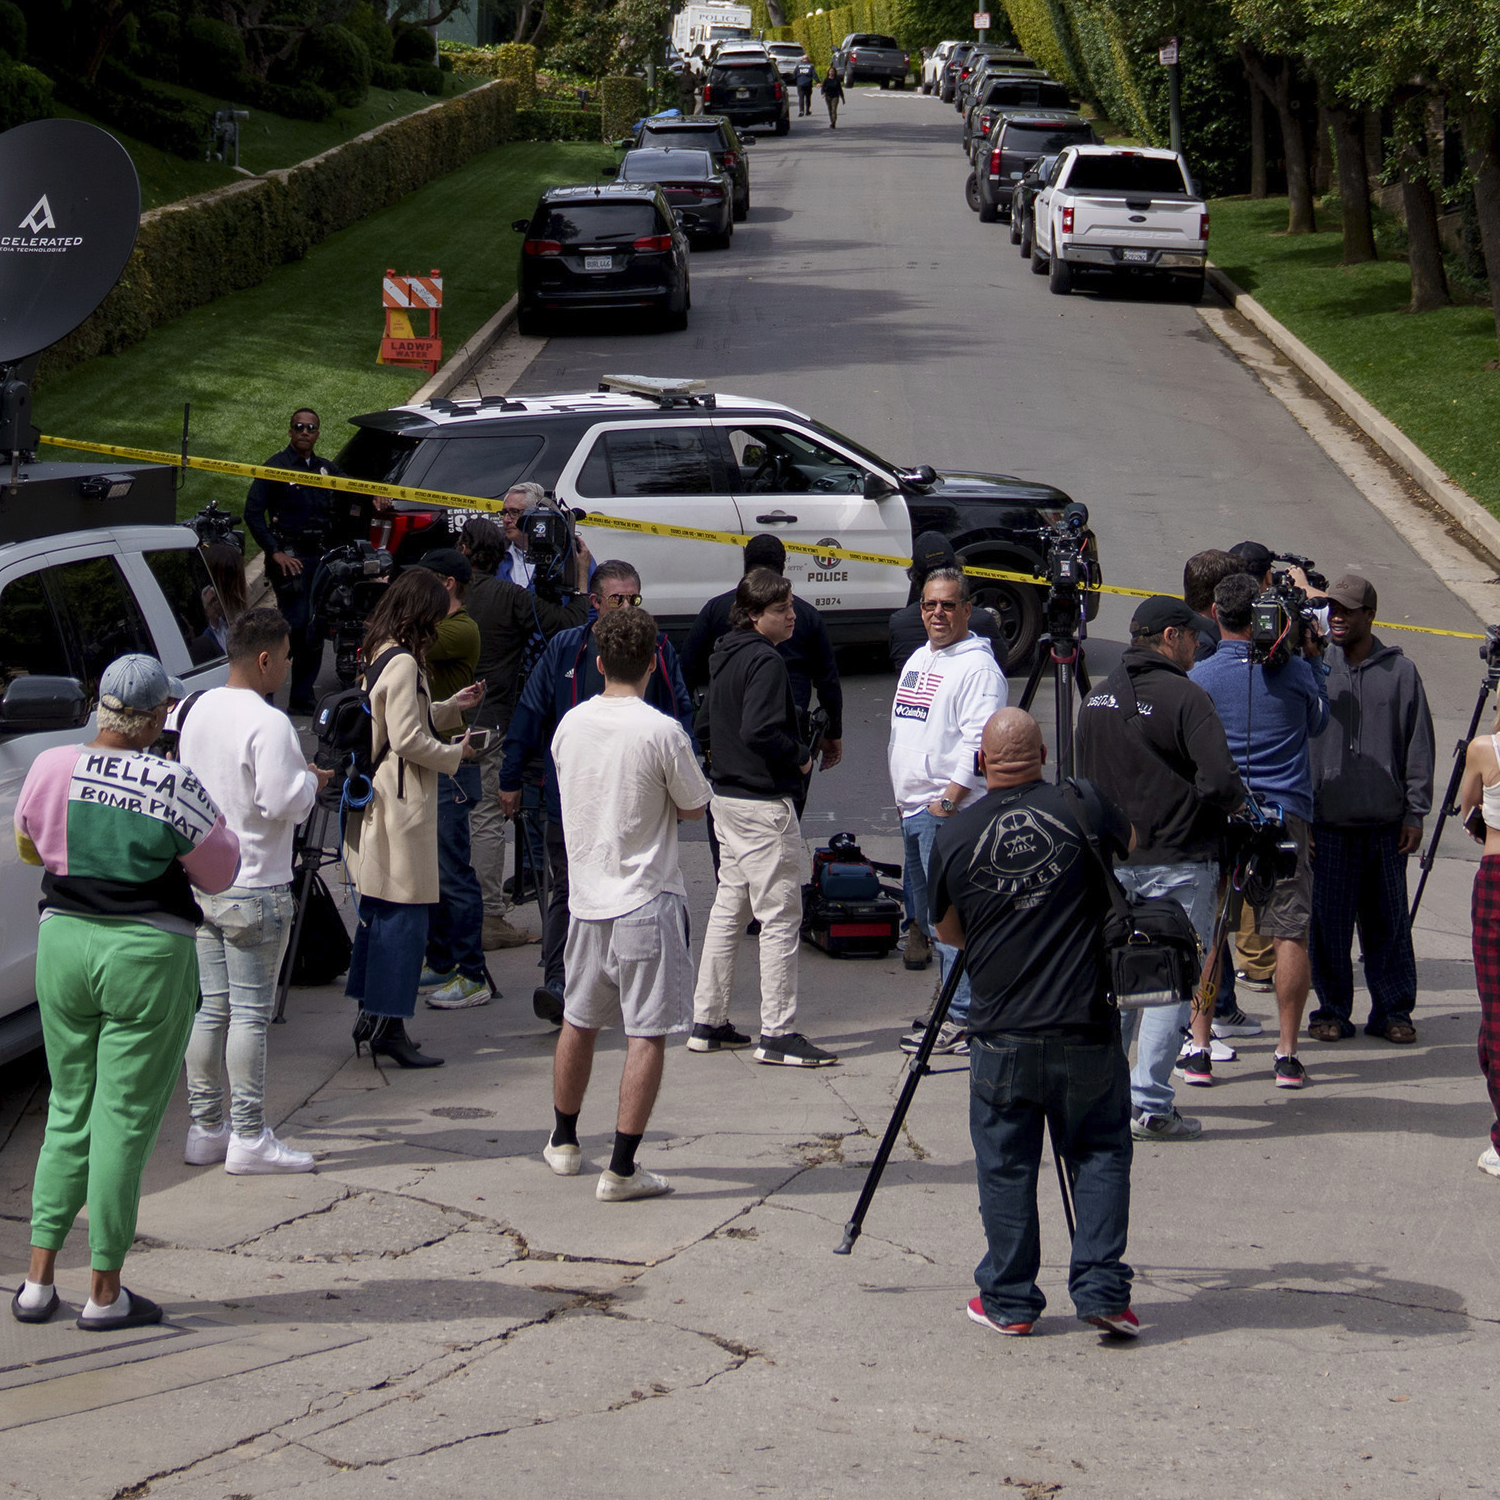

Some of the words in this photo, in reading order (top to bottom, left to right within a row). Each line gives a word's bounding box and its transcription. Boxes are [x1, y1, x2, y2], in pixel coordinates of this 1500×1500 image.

[699, 14, 741, 22] POLICE
[390, 341, 433, 351] LADWP
[395, 350, 428, 358] WATER
[670, 528, 682, 536] CROSS
[704, 532, 717, 540] POLICE
[788, 544, 802, 552] POLICIA
[849, 553, 862, 561] CROSS
[886, 558, 900, 566] POLICE
[807, 572, 849, 583] POLICE
[815, 598, 842, 606] 83074
[901, 706, 927, 719] Columbia
[86, 755, 176, 798] HELLA
[80, 786, 142, 814] BOMB
[149, 798, 204, 841] PHAT
[997, 862, 1062, 893] VADER
